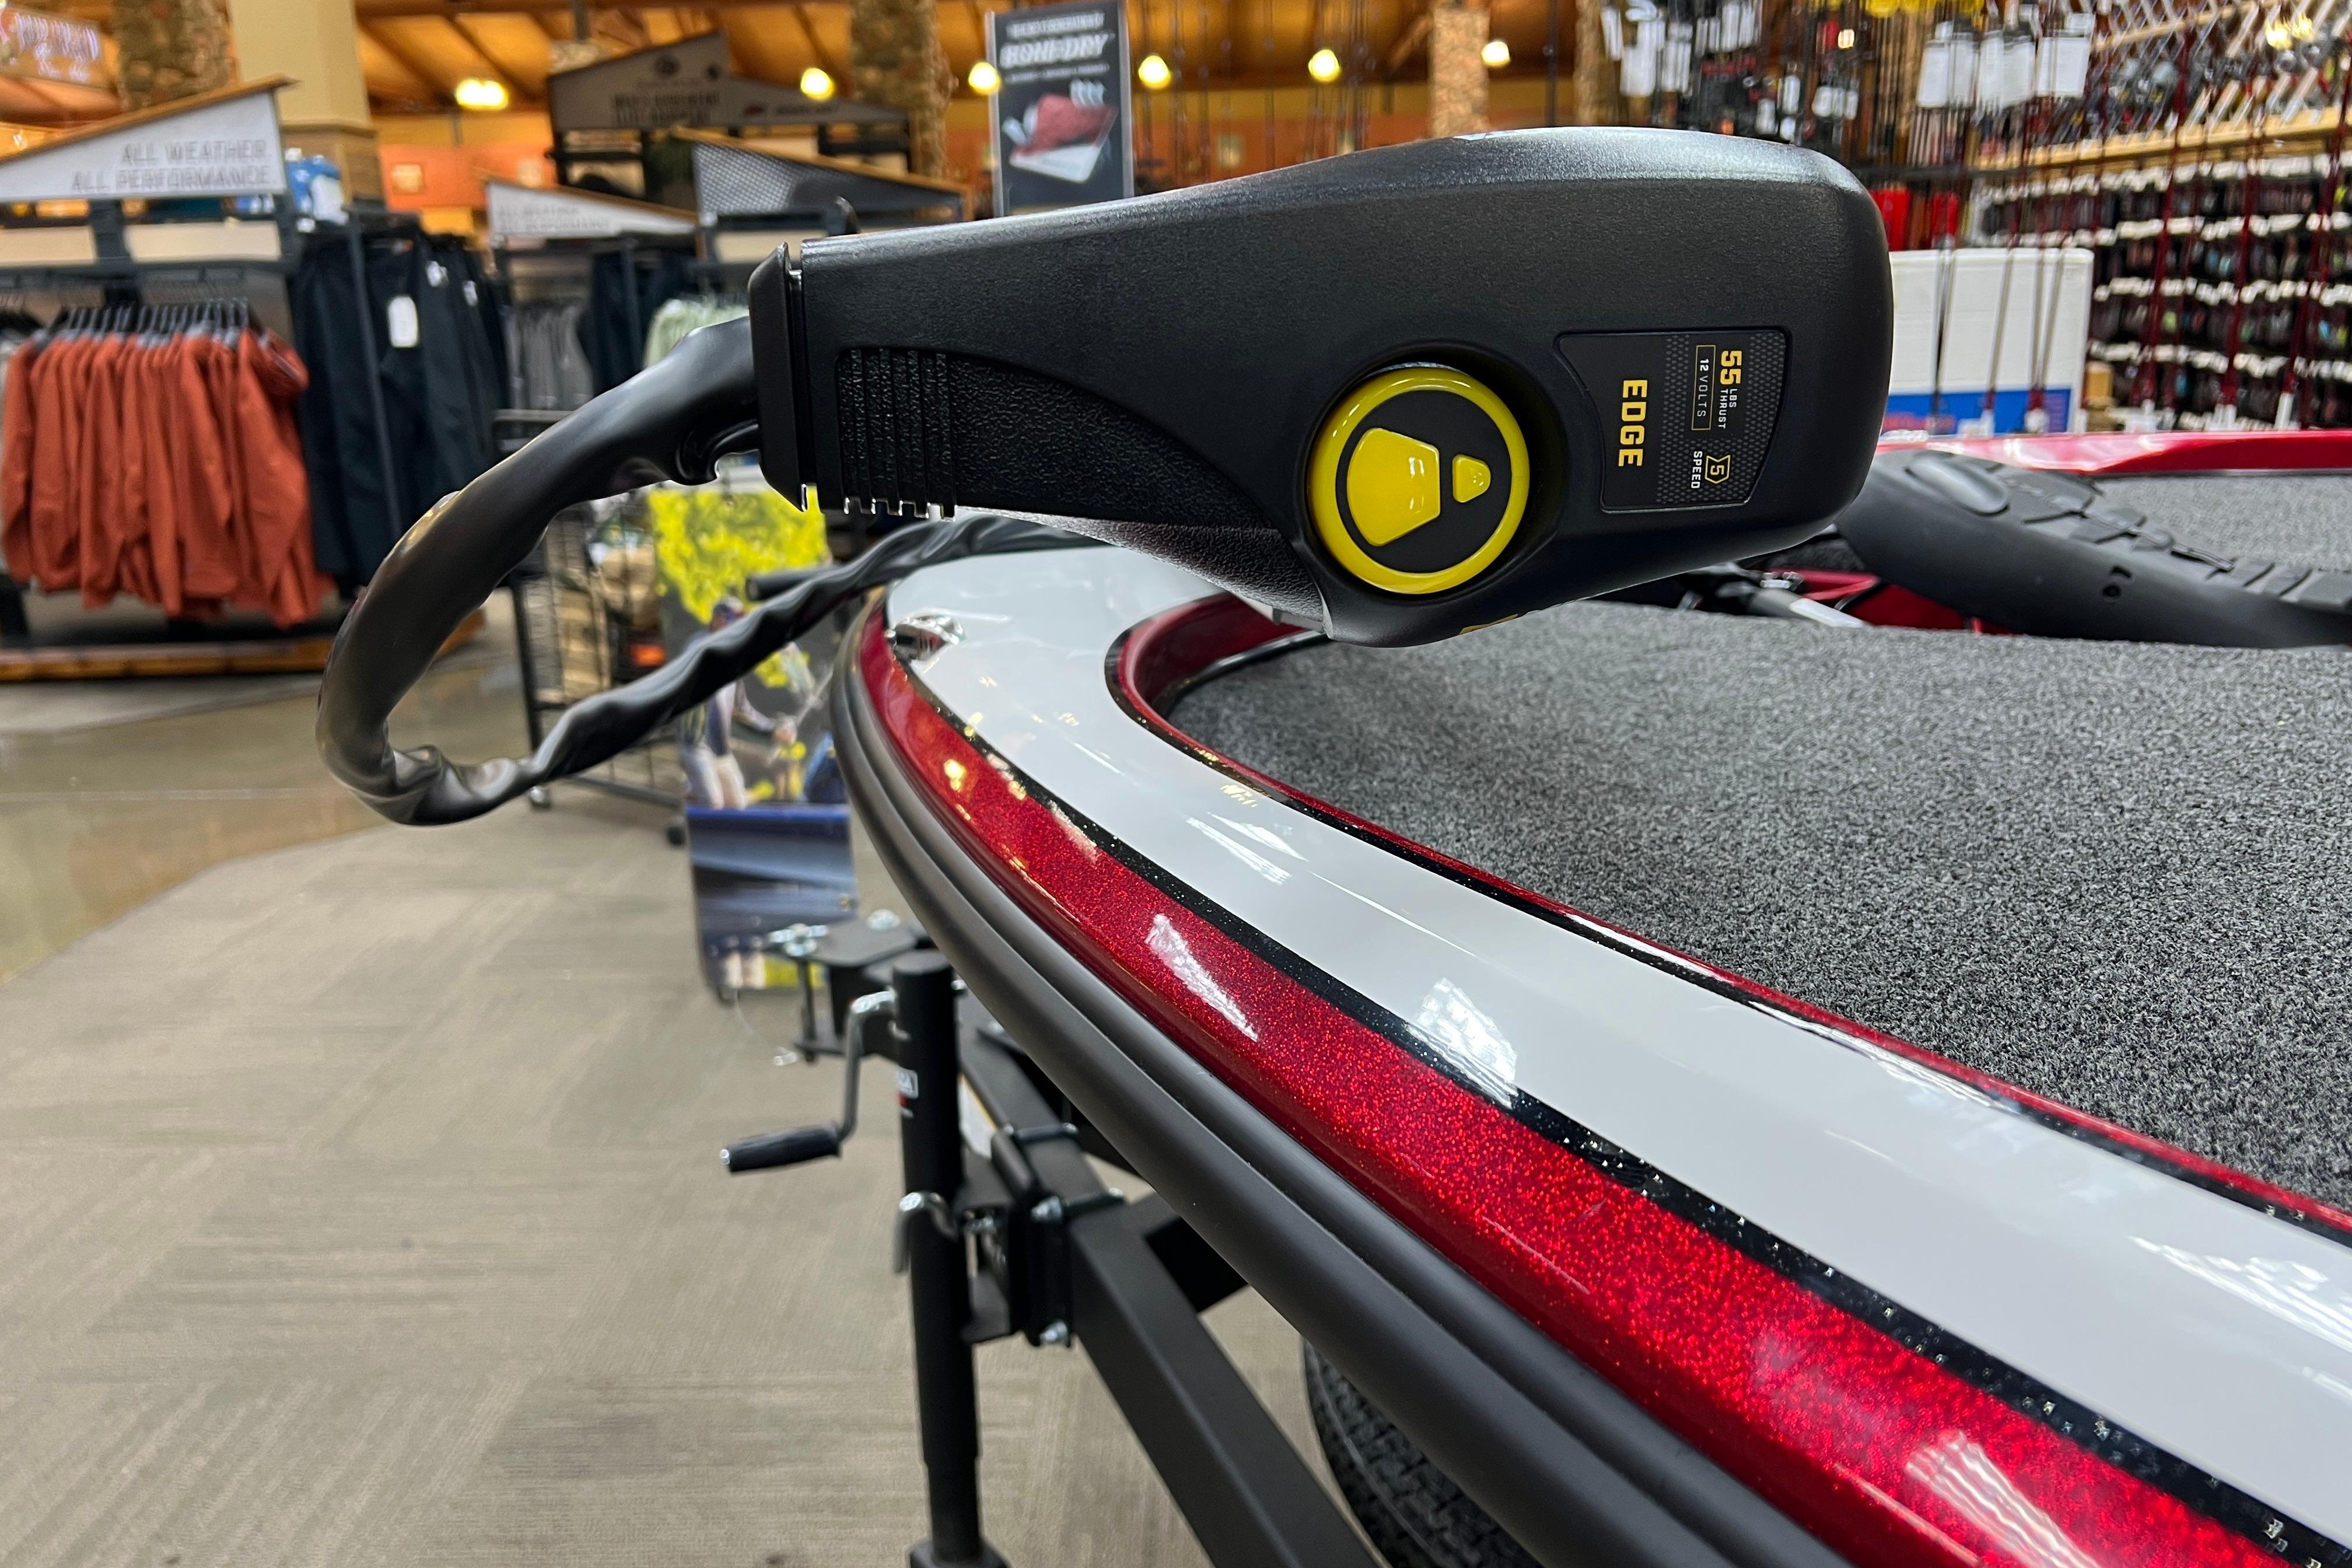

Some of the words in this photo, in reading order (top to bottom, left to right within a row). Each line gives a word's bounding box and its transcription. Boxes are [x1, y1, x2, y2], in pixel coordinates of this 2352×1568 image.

[122, 142, 158, 163] ALL
[72, 170, 107, 191] ALL
[1700, 358, 1709, 372] 12
[1720, 350, 1742, 385] 55
[1697, 375, 1709, 417] VOLTS
[1718, 388, 1728, 429] THRUST
[1729, 388, 1738, 408] LBS
[1618, 380, 1648, 467] EDGE
[1690, 451, 1703, 489] SPEED
[1710, 465, 1725, 475] 5
